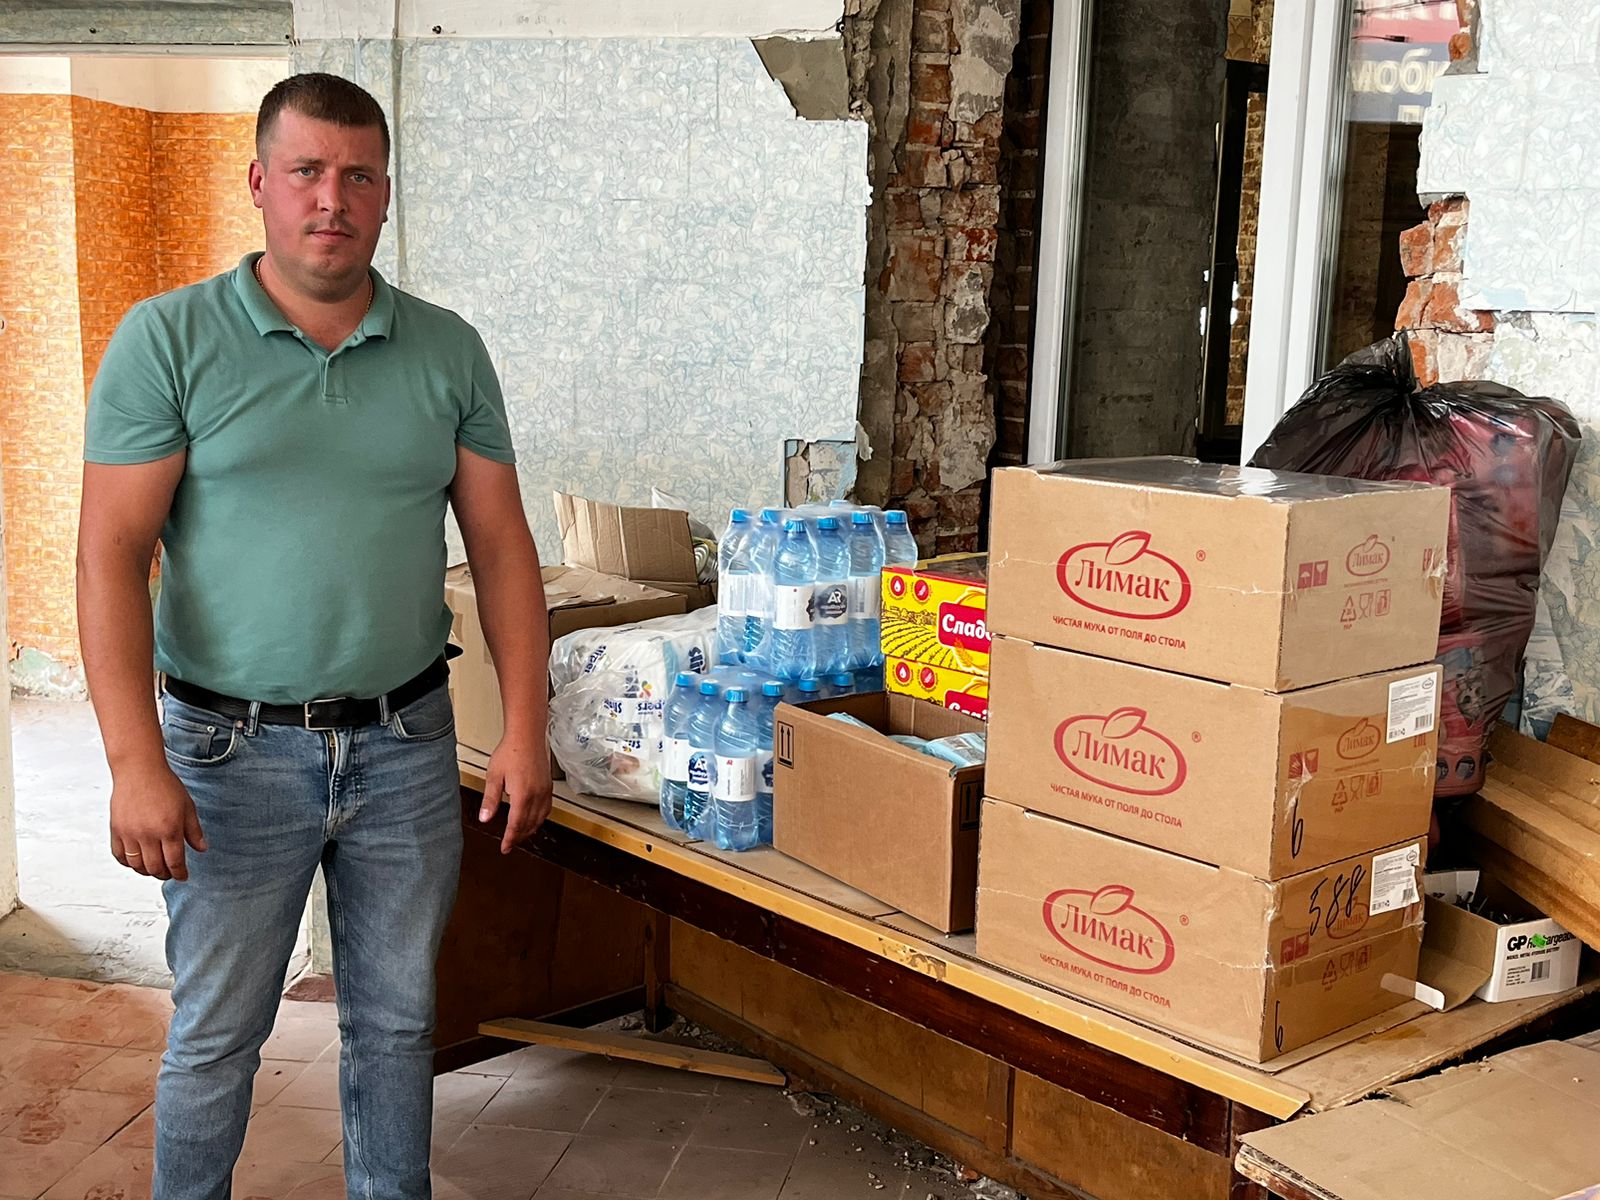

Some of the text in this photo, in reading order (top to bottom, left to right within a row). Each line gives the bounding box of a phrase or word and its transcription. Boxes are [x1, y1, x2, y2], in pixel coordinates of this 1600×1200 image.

[1074, 559, 1170, 602] Лимак
[1352, 552, 1384, 568] Лимак
[827, 591, 842, 604] AR
[1053, 615, 1186, 650] ЧИСТАЯ МУКА ОТ ПОЛЯ ДО СТОЛА
[1071, 730, 1165, 779] Лимак
[1050, 783, 1182, 828] ЧИСТАЯ МУКА ОТ ПОЛЯ ДО СТОЛА
[1309, 864, 1366, 936] 588
[1061, 903, 1153, 960] Лимак
[1507, 935, 1527, 952] GP
[1040, 953, 1171, 1008] ЧИСТАЯ МУКА ОТ ПОЛЯ ДО СТОЛА
[1274, 1001, 1283, 1053] 6
